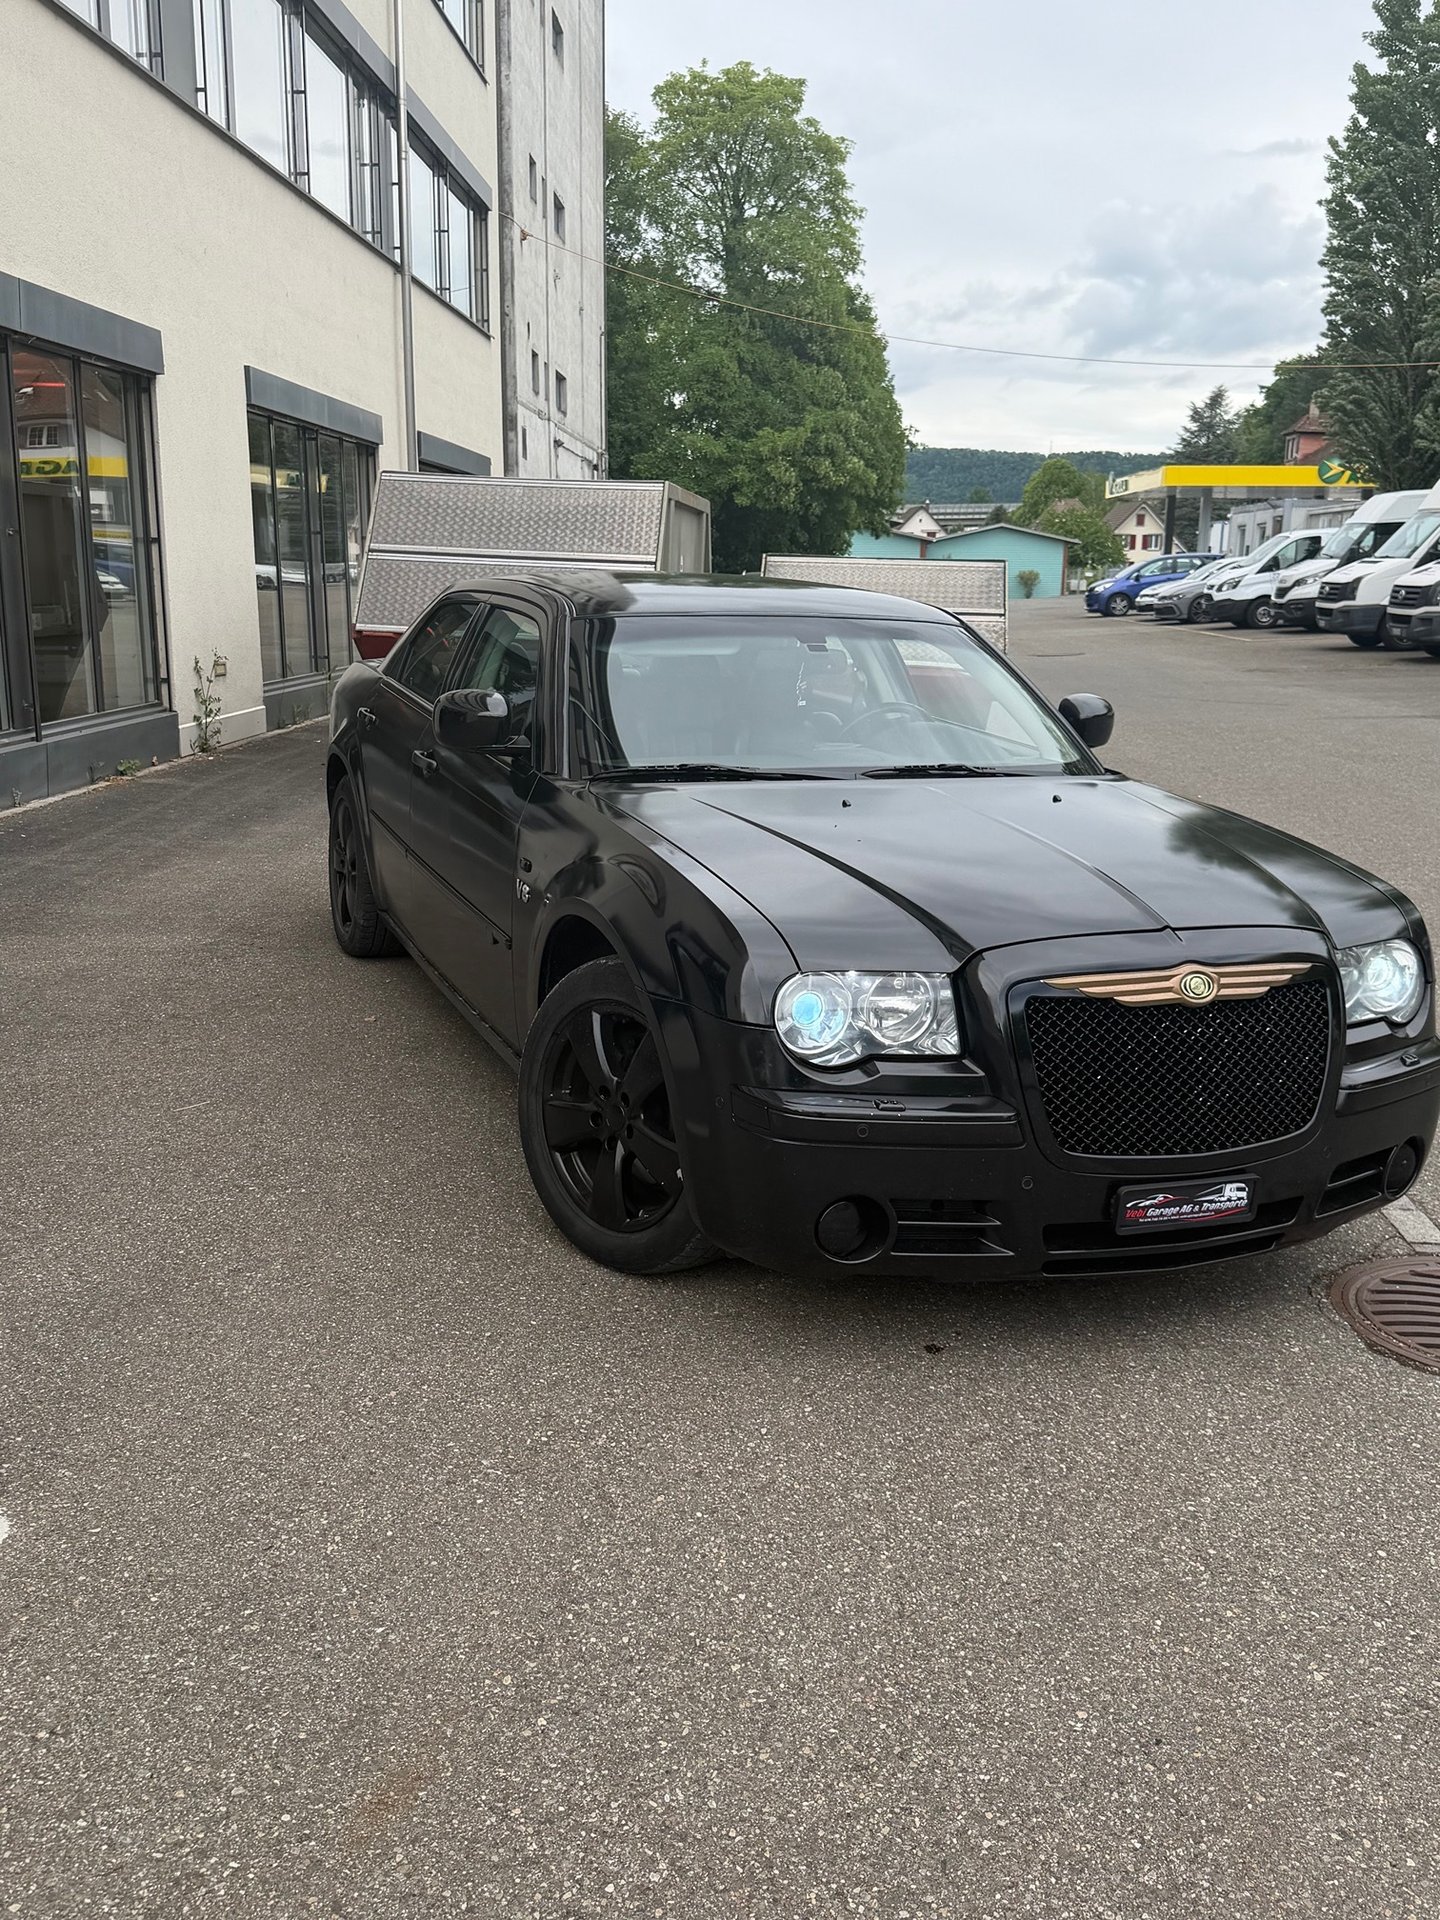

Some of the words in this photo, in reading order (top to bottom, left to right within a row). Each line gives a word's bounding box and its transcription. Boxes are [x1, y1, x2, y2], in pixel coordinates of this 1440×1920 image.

[1146, 1206, 1179, 1217] Garage
[1179, 1204, 1193, 1213] AG
[1201, 1200, 1248, 1211] Transporte
